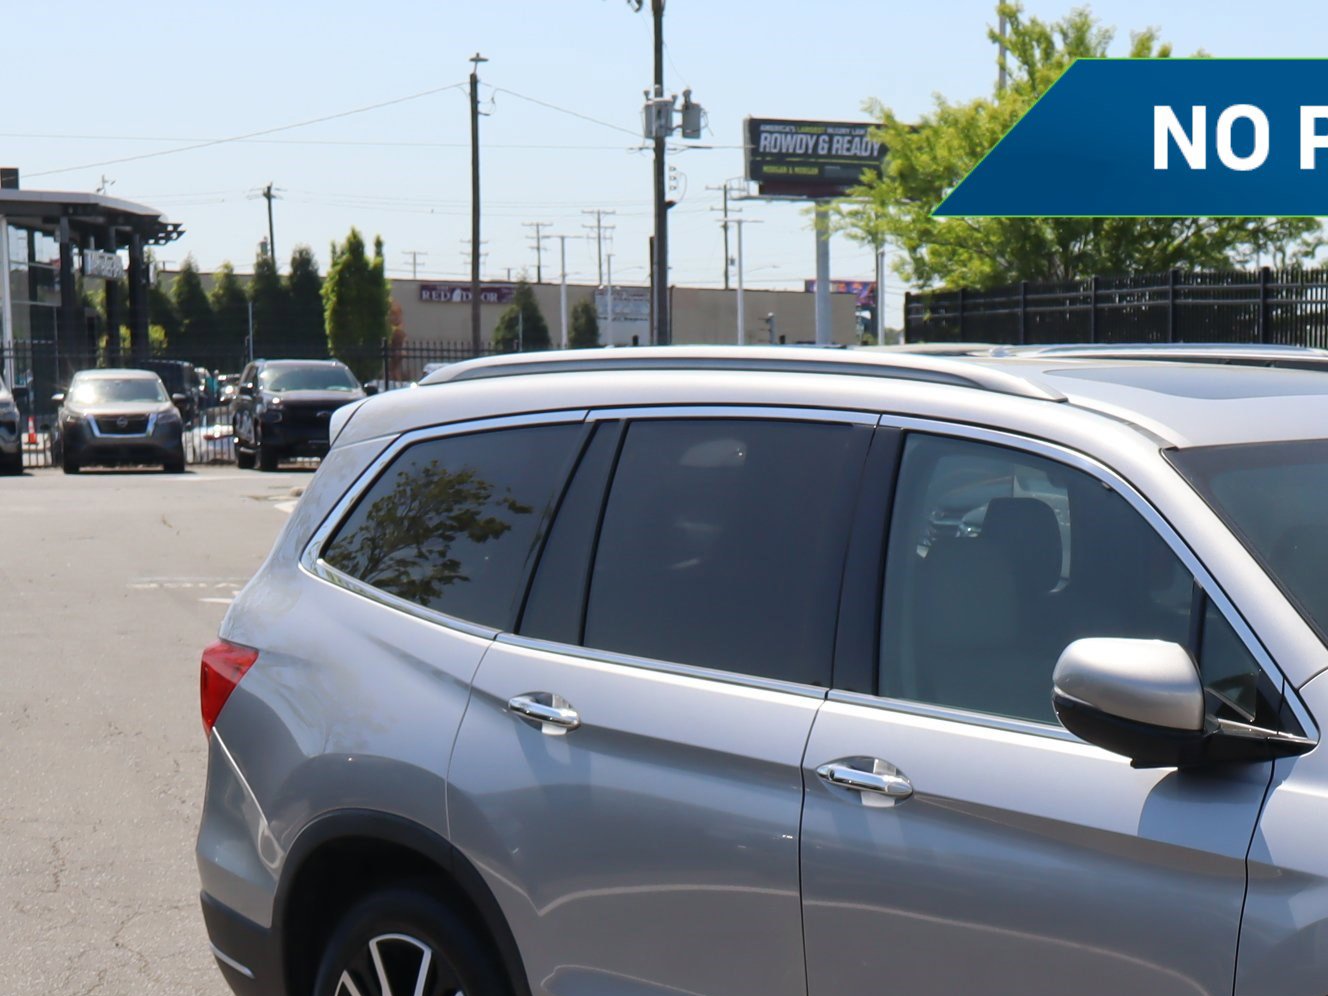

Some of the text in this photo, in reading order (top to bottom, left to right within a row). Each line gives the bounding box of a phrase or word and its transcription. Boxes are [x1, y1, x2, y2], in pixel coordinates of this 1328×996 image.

[759, 132, 817, 153] ROWDY
[831, 135, 882, 158] READY
[421, 289, 498, 302] RED DOR
